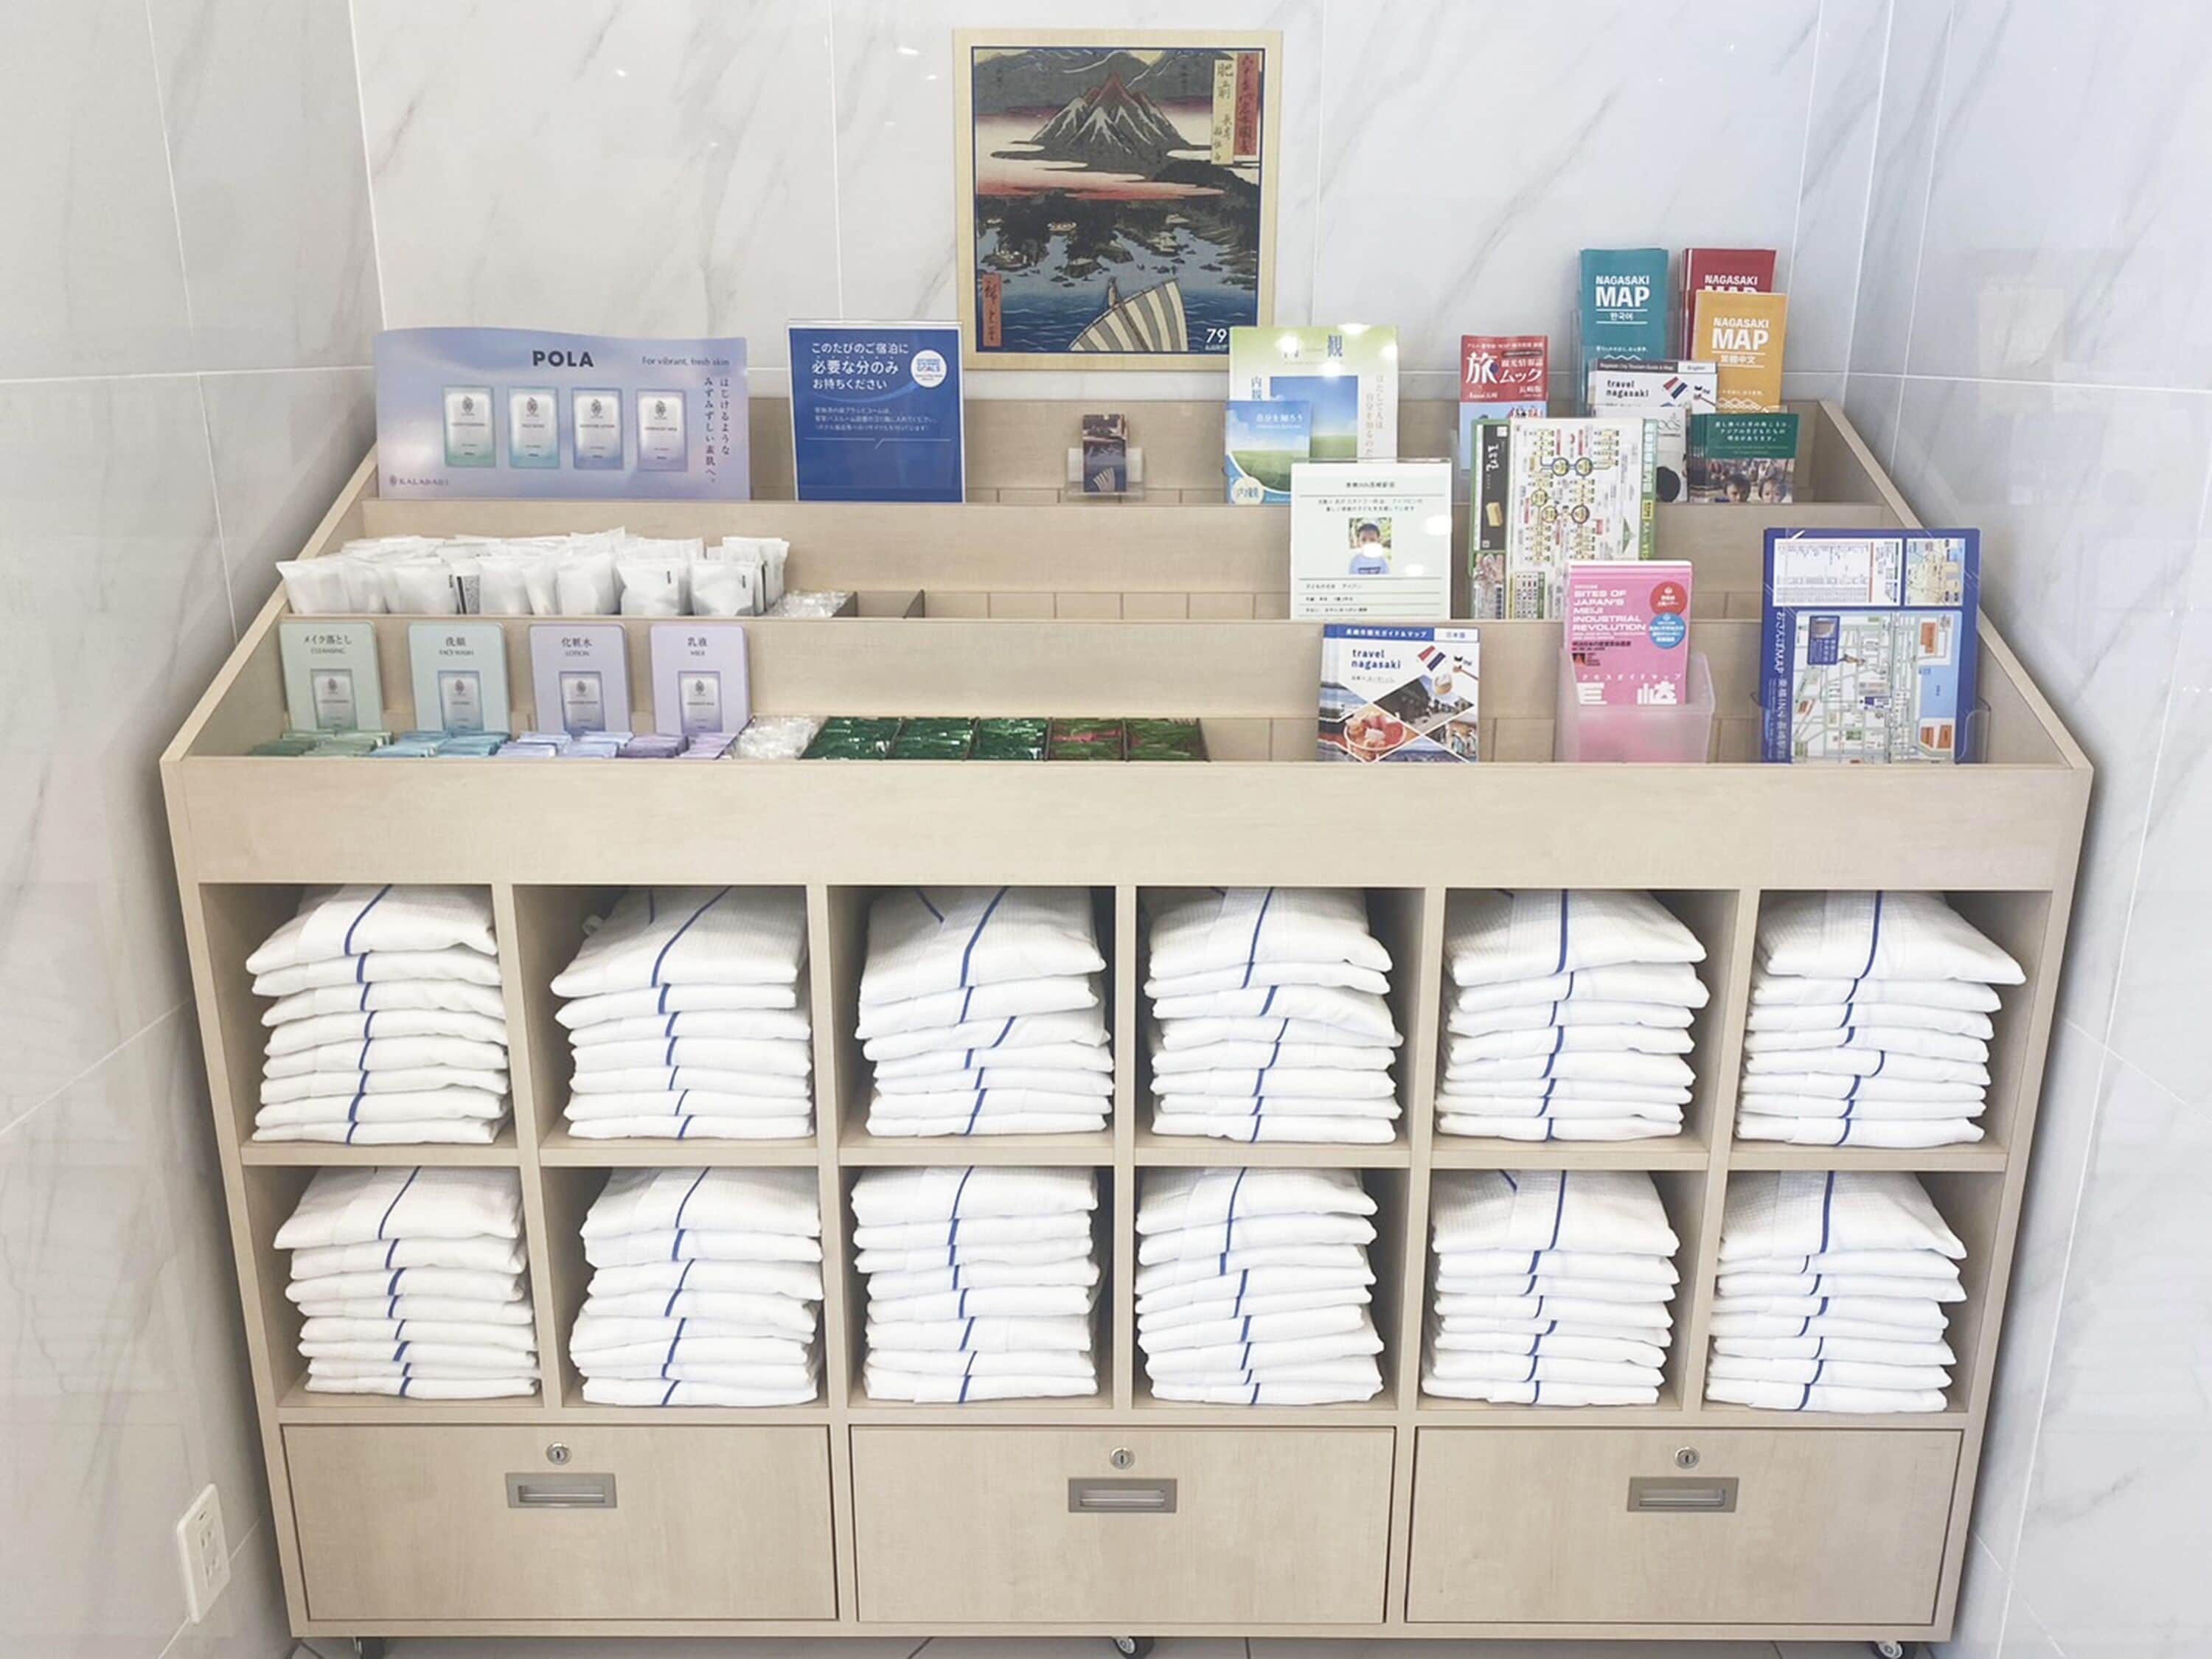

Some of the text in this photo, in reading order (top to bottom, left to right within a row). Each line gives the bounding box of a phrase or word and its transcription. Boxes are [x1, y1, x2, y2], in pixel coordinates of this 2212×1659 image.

[1596, 275, 1649, 285] NAGASAKI
[1705, 274, 1759, 285] NAGASAKI
[1596, 286, 1650, 307] MAP
[1713, 317, 1770, 329] NAGASAKI
[1206, 328, 1228, 344] 79
[1711, 328, 1770, 351] MAP
[812, 343, 909, 354] このたびのご宿泊に
[532, 350, 594, 367] POLA
[812, 360, 899, 375] 必要な分のみ
[1465, 352, 1498, 383] 旅
[1500, 368, 1543, 383] ムック
[813, 378, 888, 391] お持ちください
[1607, 380, 1635, 388] travel
[1606, 390, 1649, 398] nagasaki
[720, 378, 730, 455] はじけるような
[1574, 590, 1607, 598] SITES
[1573, 598, 1624, 606] JAPAN'S
[304, 634, 352, 645] メイク落とし
[445, 636, 467, 647] 洗顔
[561, 636, 593, 647] 化粧水
[687, 636, 708, 647] 乳液
[1352, 649, 1385, 658] travel
[1352, 660, 1401, 670] nagasaki
